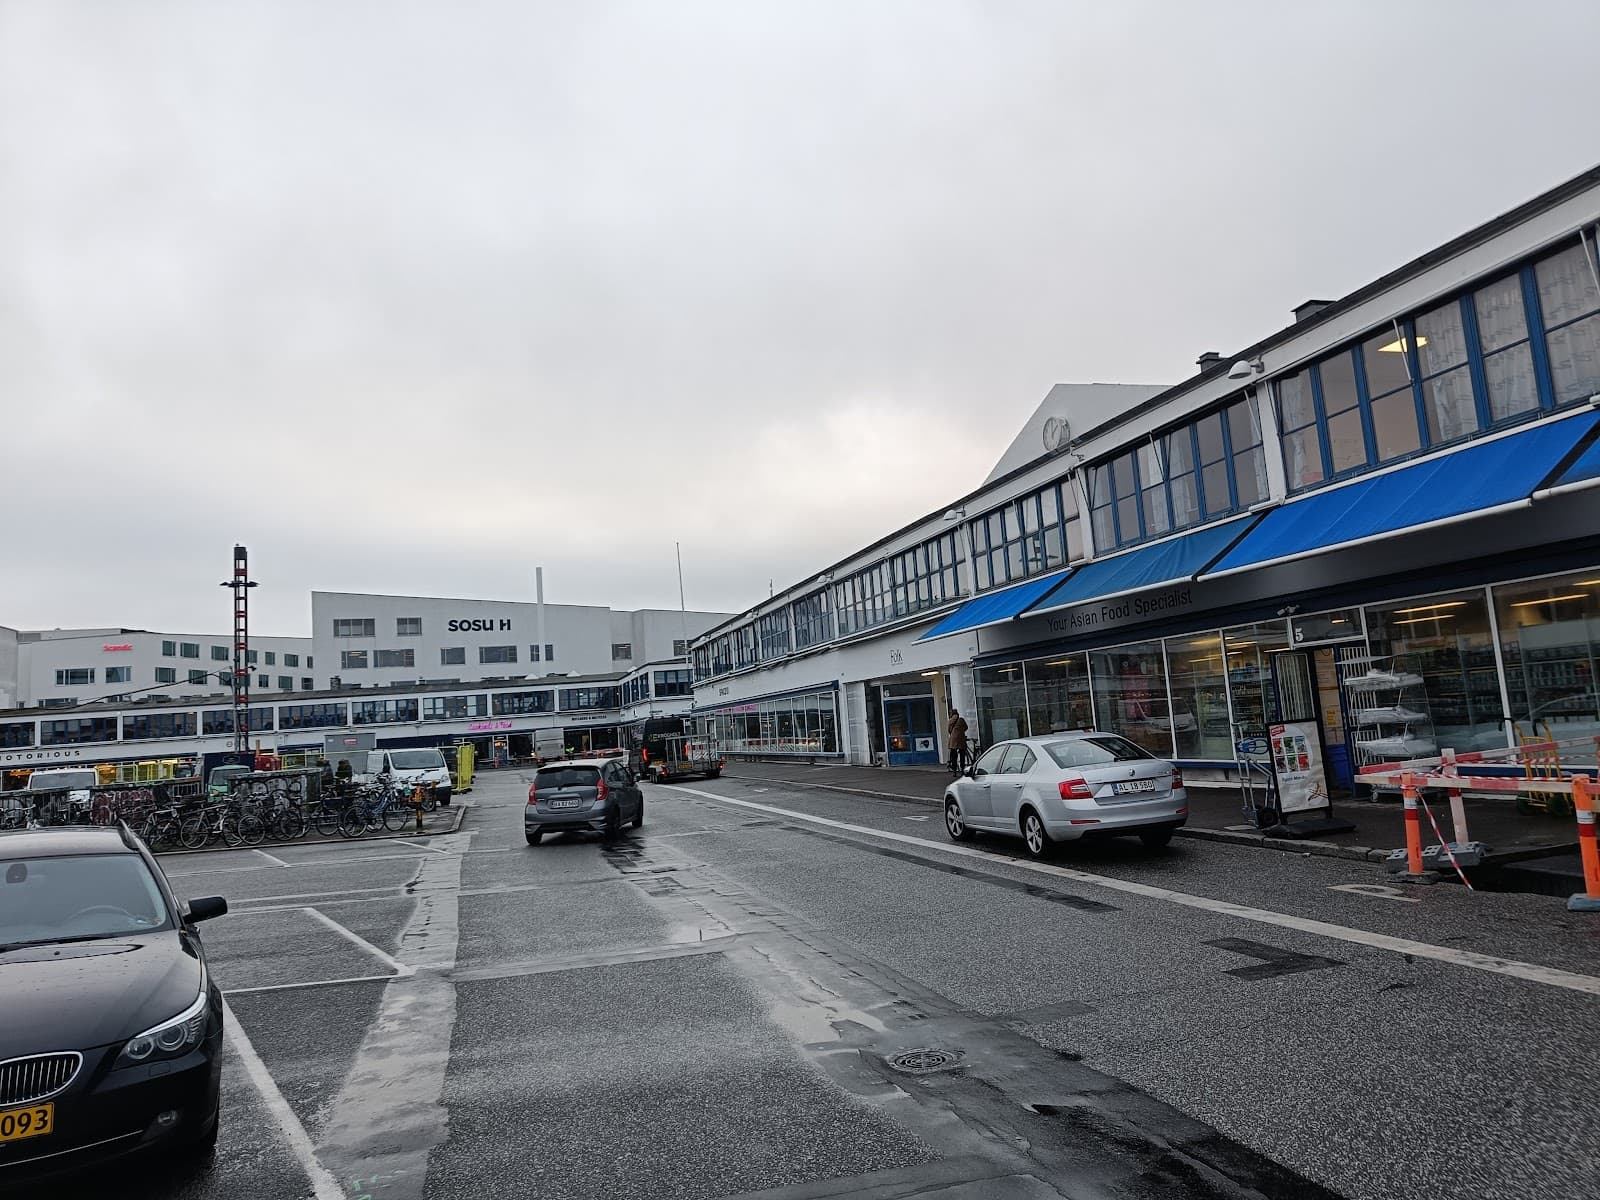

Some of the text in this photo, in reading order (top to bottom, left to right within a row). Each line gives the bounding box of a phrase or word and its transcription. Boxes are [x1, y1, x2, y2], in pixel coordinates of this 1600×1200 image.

[1047, 589, 1193, 633] Your Asian Food Specialist
[448, 619, 511, 632] SOSU H
[1295, 627, 1304, 642] 5
[1119, 784, 1129, 792] AL
[1, 1109, 49, 1137] 093
